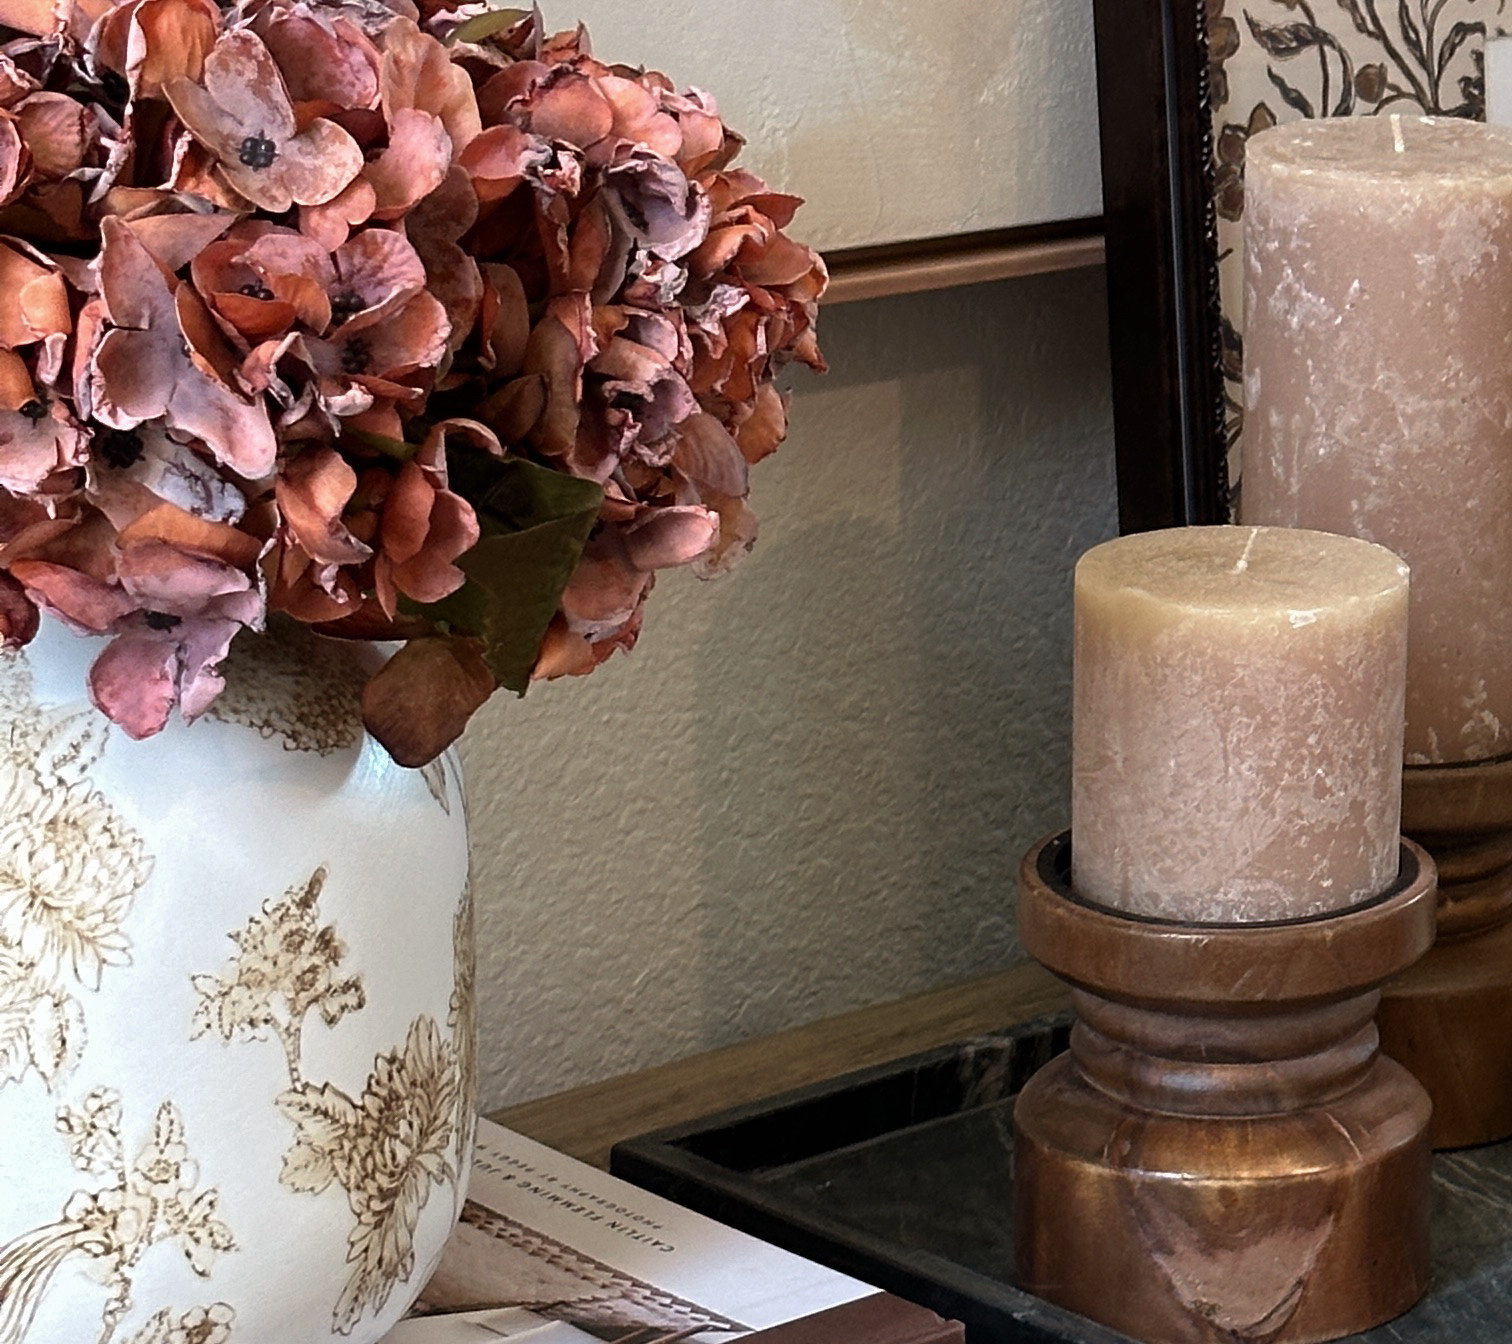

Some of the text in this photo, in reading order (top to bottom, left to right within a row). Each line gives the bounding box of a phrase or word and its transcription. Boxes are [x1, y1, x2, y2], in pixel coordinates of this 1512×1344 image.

[517, 1181, 603, 1222] FLEMMING
[560, 1184, 664, 1230] PHOTOGRAPHY
[606, 1220, 675, 1253] CAITLIN
